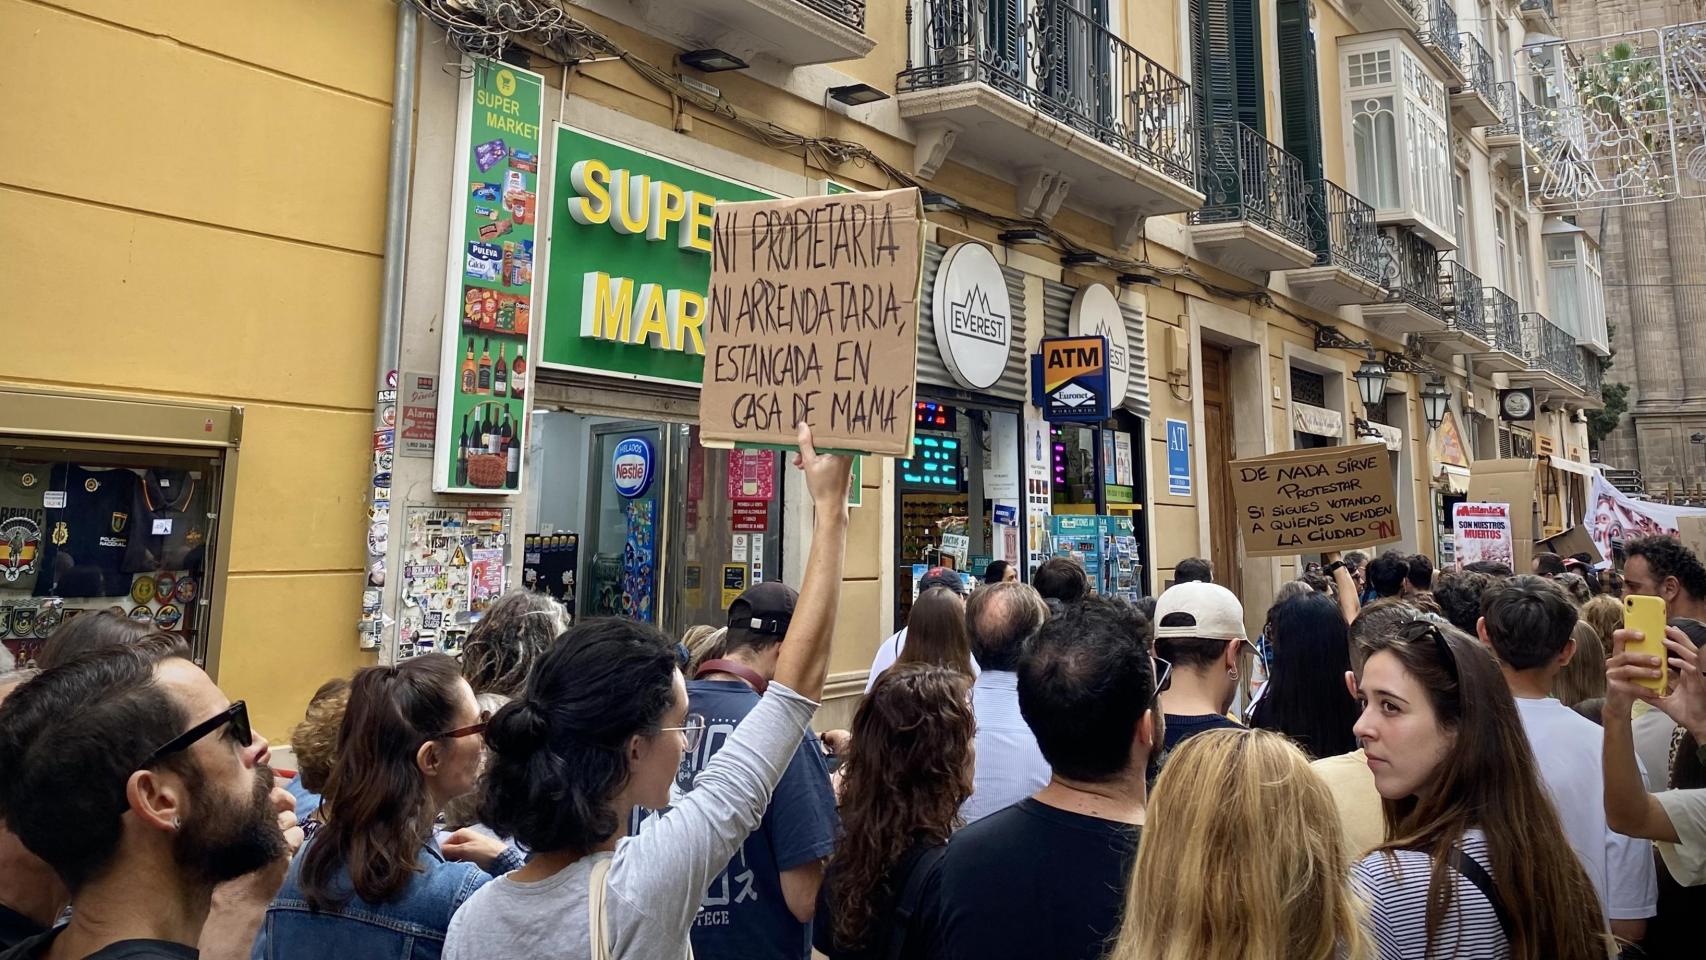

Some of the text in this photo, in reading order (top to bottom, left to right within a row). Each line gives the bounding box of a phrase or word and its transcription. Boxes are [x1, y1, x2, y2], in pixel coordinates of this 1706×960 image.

[477, 89, 519, 116] SUPER
[486, 112, 540, 140] MARKET
[473, 244, 498, 257] PULEVA
[713, 202, 900, 274] NI PROPIETARIA
[580, 271, 708, 356] MAR
[710, 283, 732, 333] NI
[955, 310, 1003, 339] EVEREST
[715, 340, 872, 388] ESTANCADA EN
[1048, 347, 1099, 369] ATM
[1059, 391, 1088, 400] Euronet
[732, 391, 782, 433] CASA
[792, 390, 821, 430] DE
[620, 443, 642, 453] HELADOS
[1170, 425, 1185, 452] AT
[1240, 466, 1269, 482] DE
[1277, 463, 1330, 482] NADA
[1327, 494, 1381, 509] VOTANDO
[1252, 522, 1265, 533] A
[1341, 505, 1392, 523] VENDEN
[1459, 521, 1505, 529] SON NUESTROS
[1277, 533, 1303, 547] LA
[1464, 529, 1502, 540] MUERTOS
